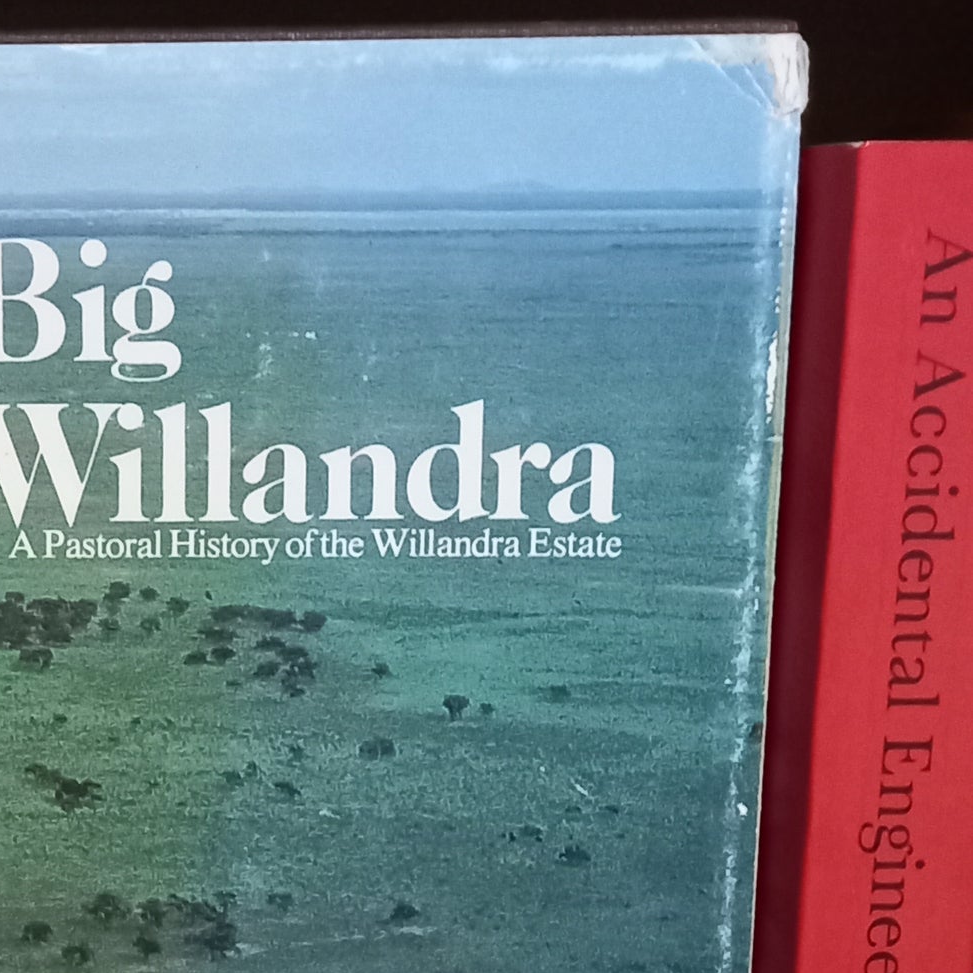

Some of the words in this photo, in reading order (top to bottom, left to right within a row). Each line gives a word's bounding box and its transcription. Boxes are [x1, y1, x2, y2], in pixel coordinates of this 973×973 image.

[920, 228, 973, 327] An
[8, 529, 37, 560] A
[44, 529, 162, 560] Pastoral
[169, 529, 279, 566] History
[285, 529, 320, 559] of
[321, 529, 364, 559] the
[371, 528, 521, 559] Willandra
[528, 528, 623, 559] Estate
[886, 349, 967, 710] Accidental
